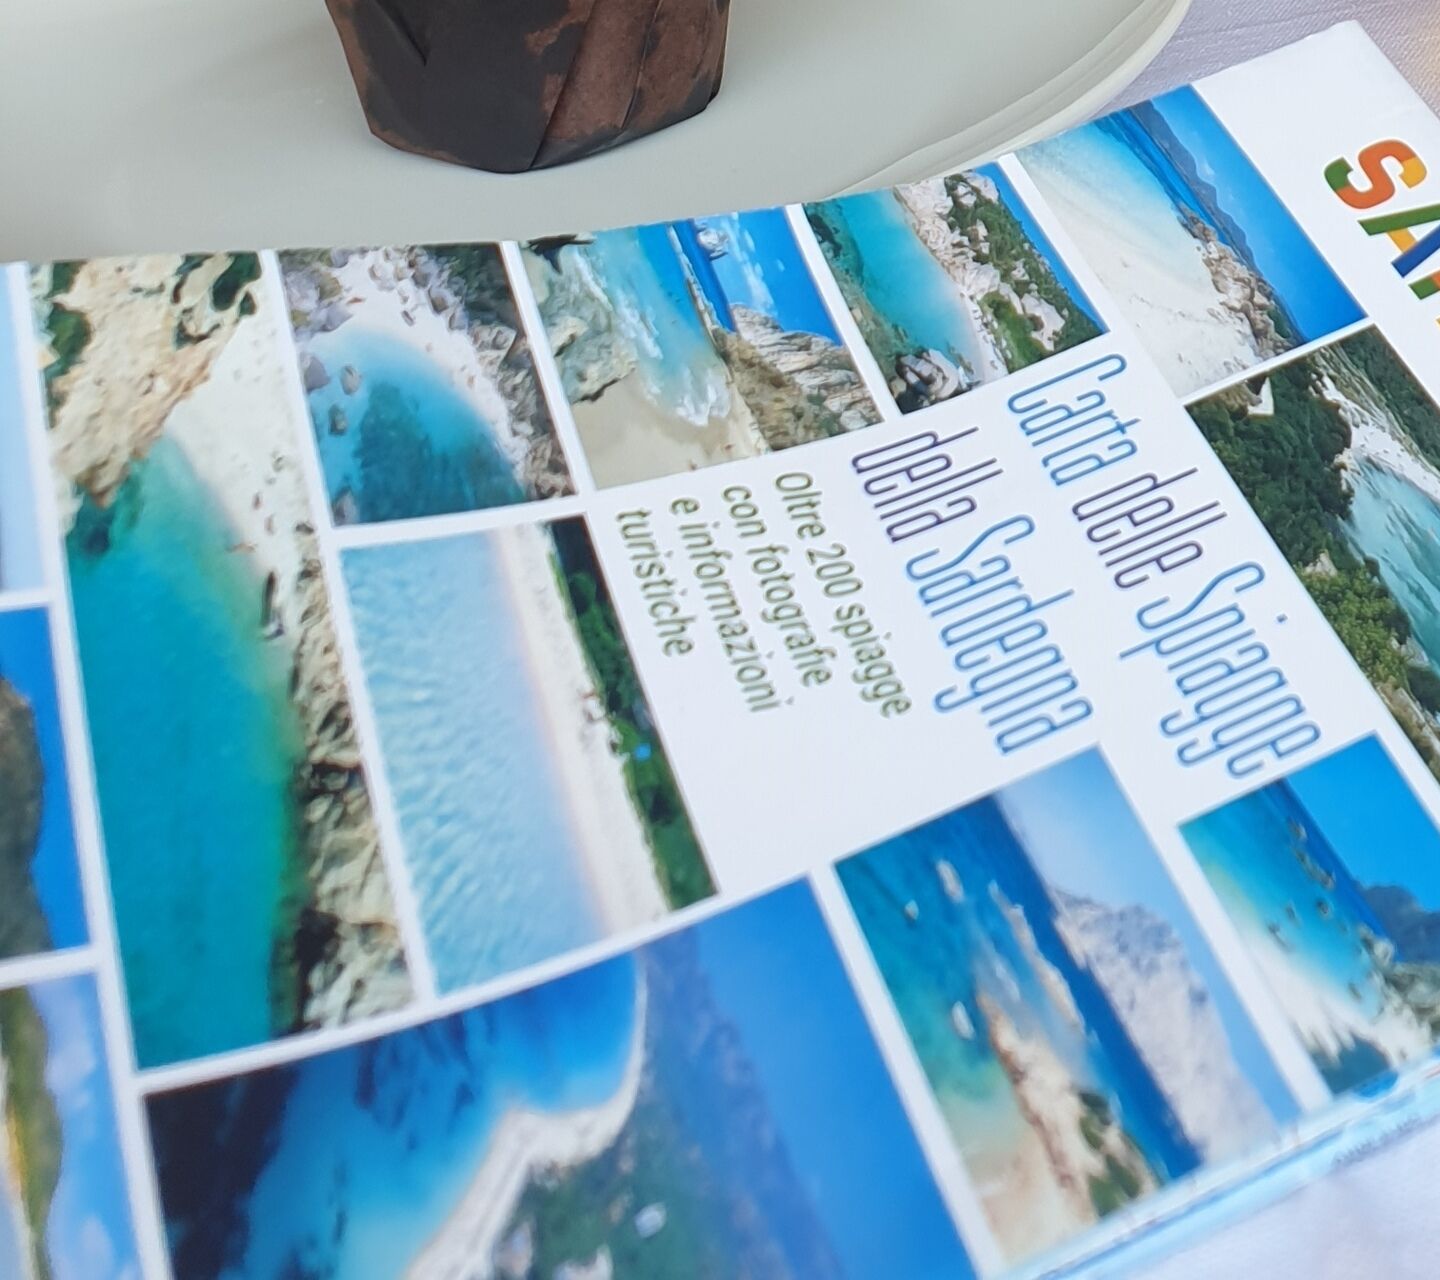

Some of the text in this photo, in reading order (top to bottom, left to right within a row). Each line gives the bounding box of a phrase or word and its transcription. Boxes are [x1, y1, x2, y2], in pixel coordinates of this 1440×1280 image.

[615, 507, 698, 658] turistiche
[669, 497, 795, 713] e informazioni
[721, 485, 838, 688] con fotografie
[774, 471, 913, 719] Oltre 200 spiagge
[851, 426, 1094, 755] della Sardegna
[1008, 353, 1321, 779] Carta delle Spiagge
